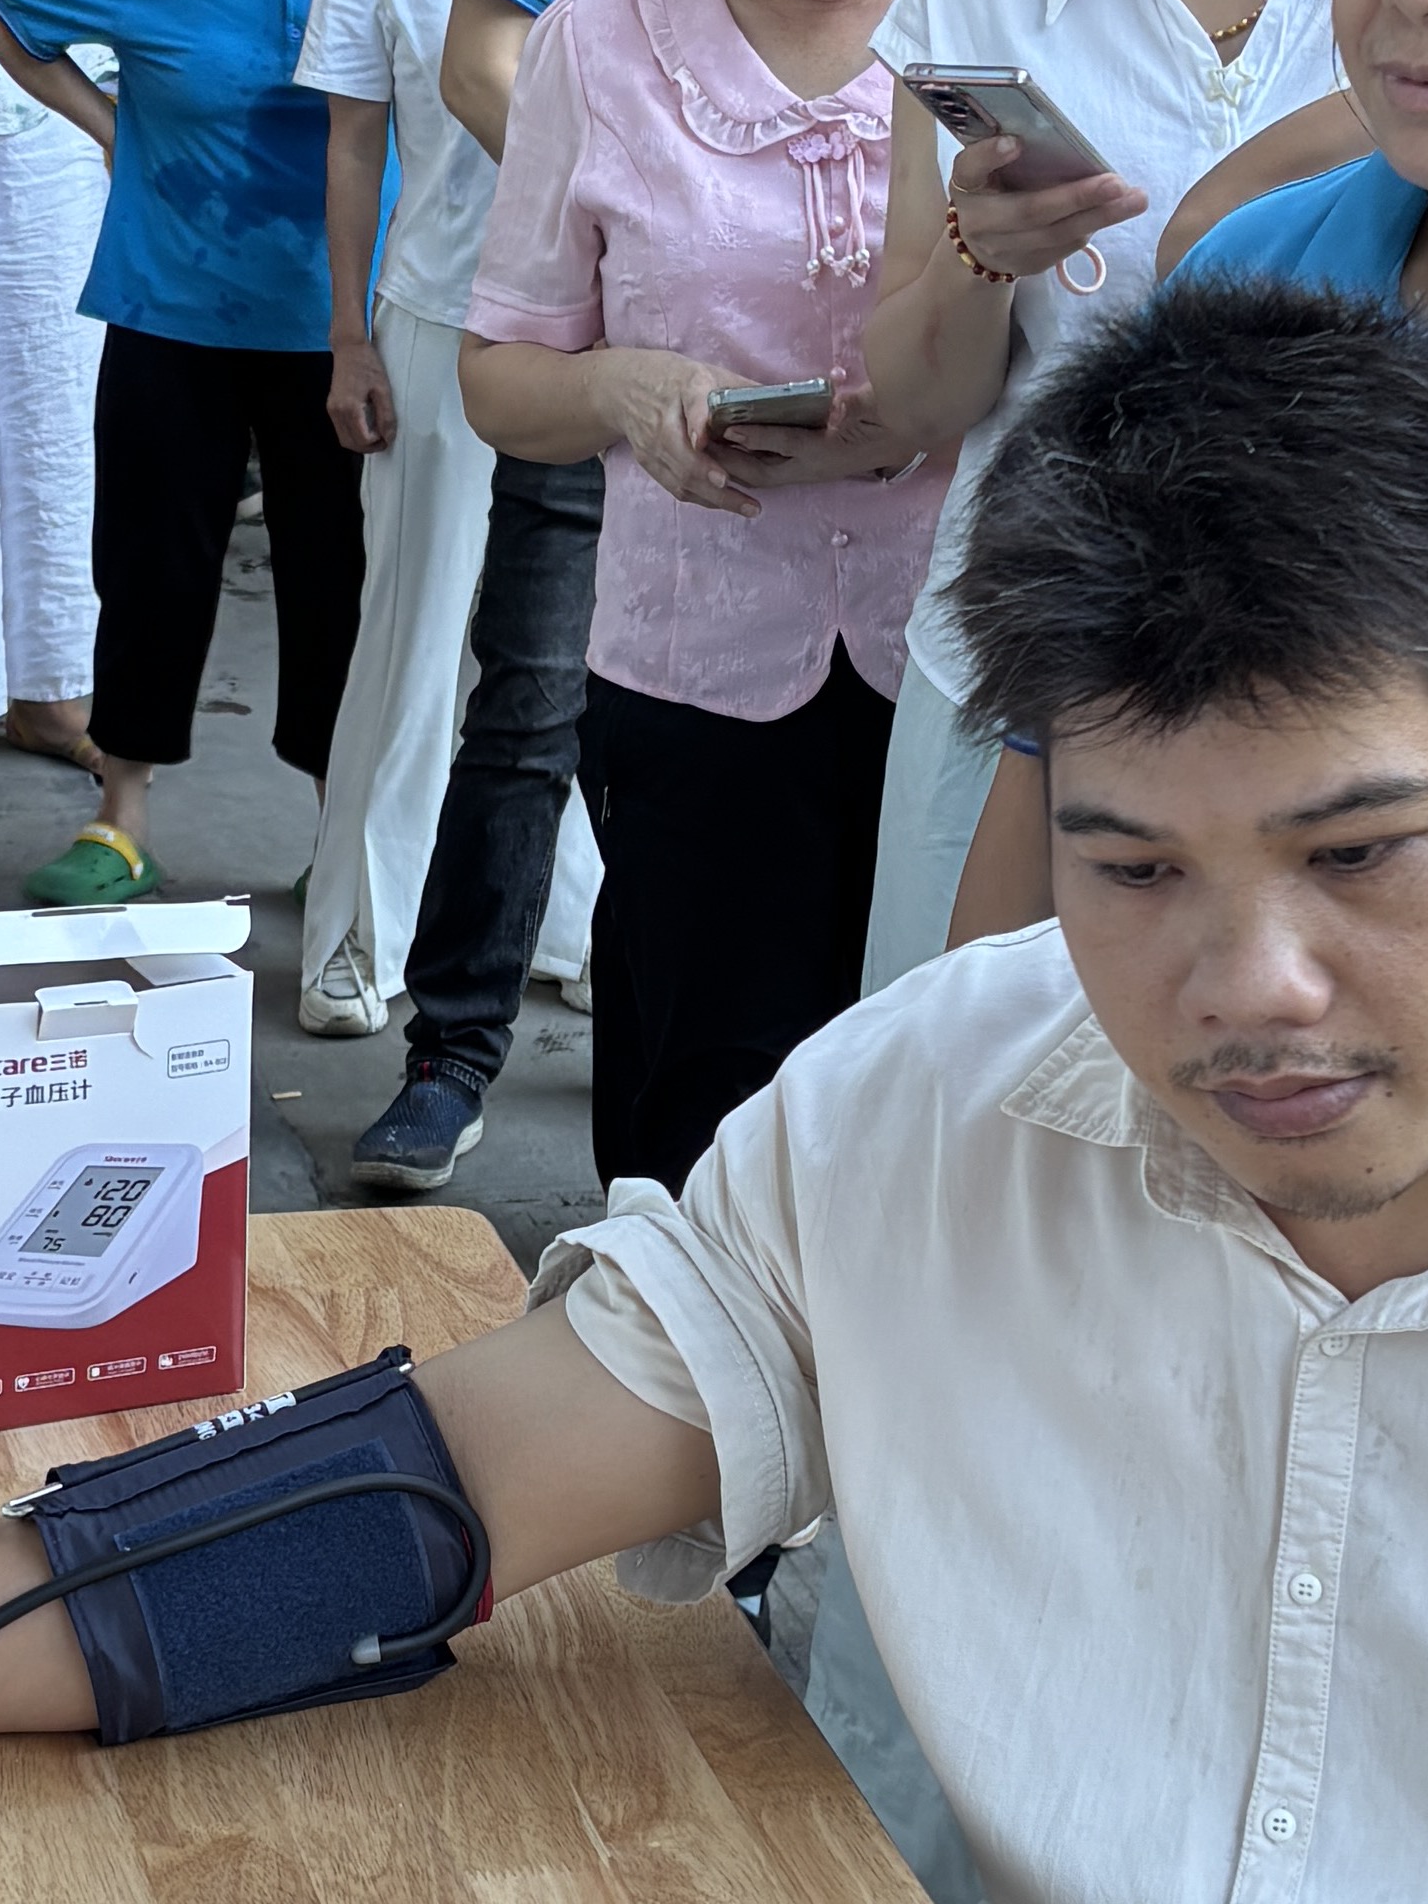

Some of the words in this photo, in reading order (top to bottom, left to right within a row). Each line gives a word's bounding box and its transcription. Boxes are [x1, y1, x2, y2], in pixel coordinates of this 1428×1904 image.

[93, 1179, 151, 1203] 120
[81, 1205, 133, 1228] 80
[42, 1236, 66, 1252] 75
